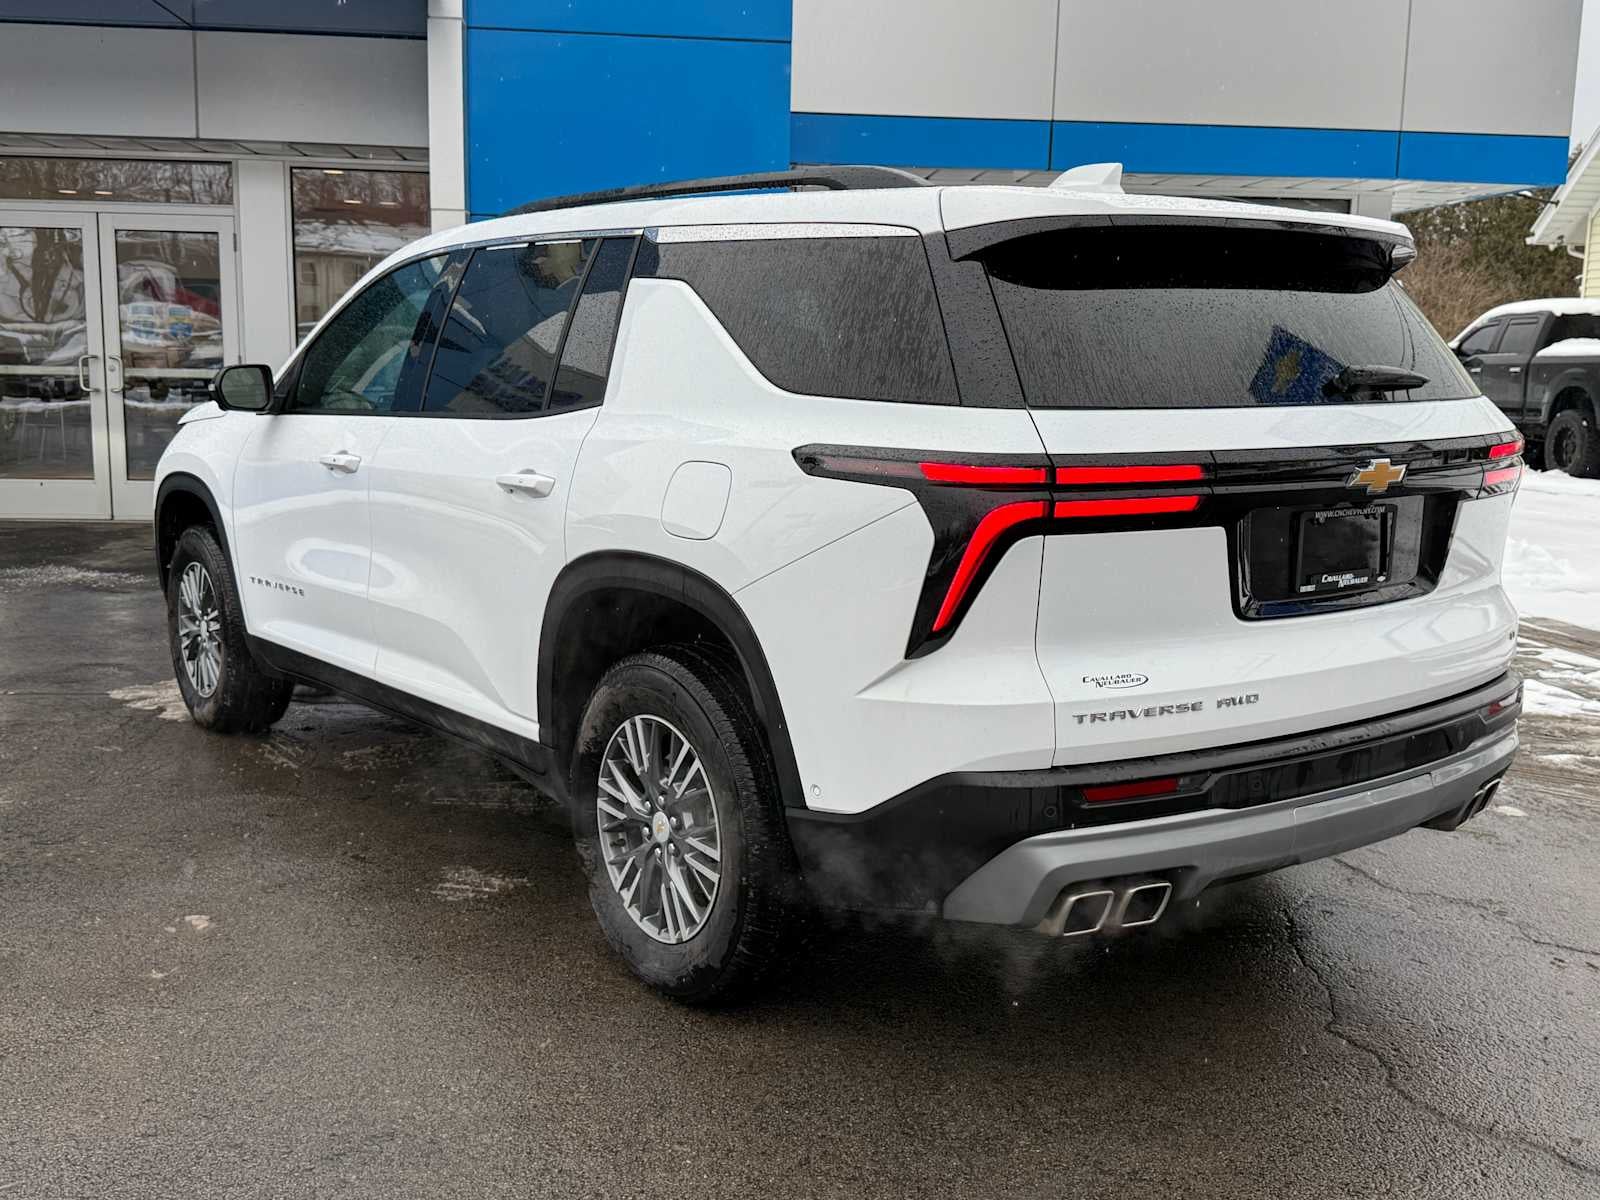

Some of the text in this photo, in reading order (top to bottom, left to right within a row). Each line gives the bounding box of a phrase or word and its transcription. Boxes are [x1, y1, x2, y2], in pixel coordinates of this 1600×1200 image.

[248, 576, 304, 597] TRAVERSE
[1082, 674, 1131, 684] CAVALLARO
[1095, 677, 1141, 688] NEUBAUER
[1072, 693, 1259, 724] TRAVERSE AWD
